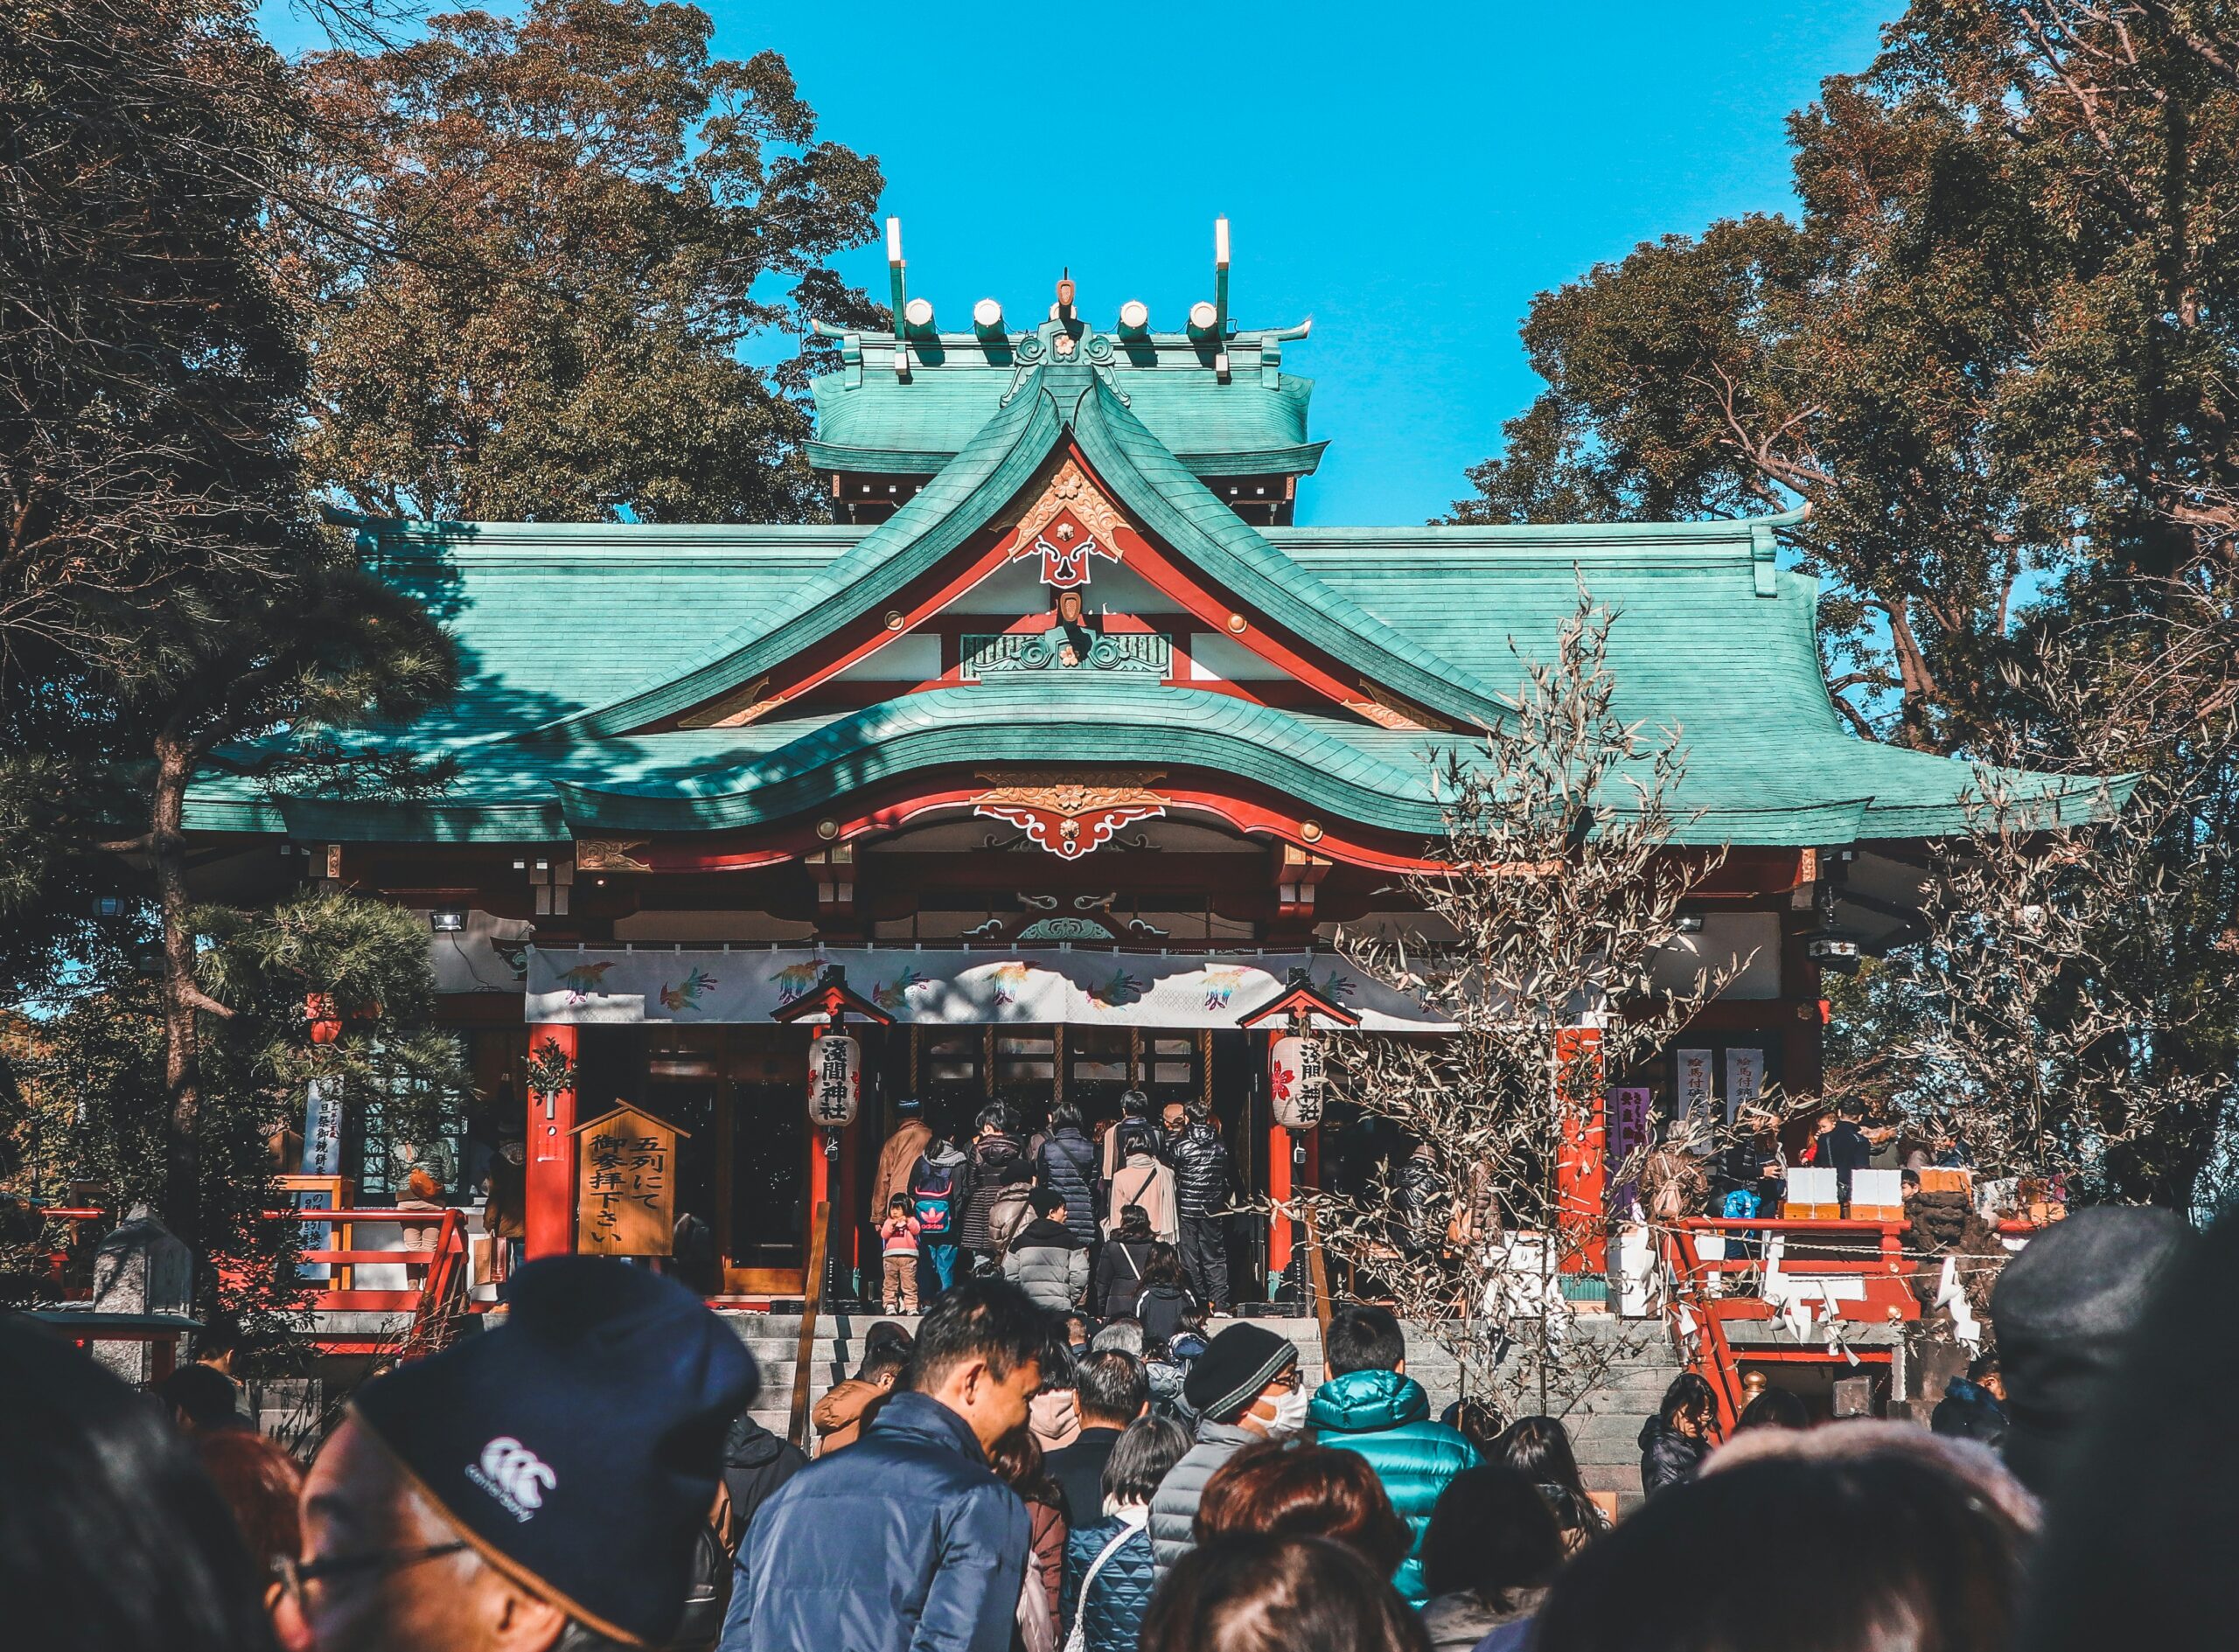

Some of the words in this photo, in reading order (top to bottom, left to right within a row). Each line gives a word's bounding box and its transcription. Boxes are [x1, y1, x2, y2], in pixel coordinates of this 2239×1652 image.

[589, 1133, 628, 1243] 御参拝下さい
[629, 1136, 668, 1210] 五列にて
